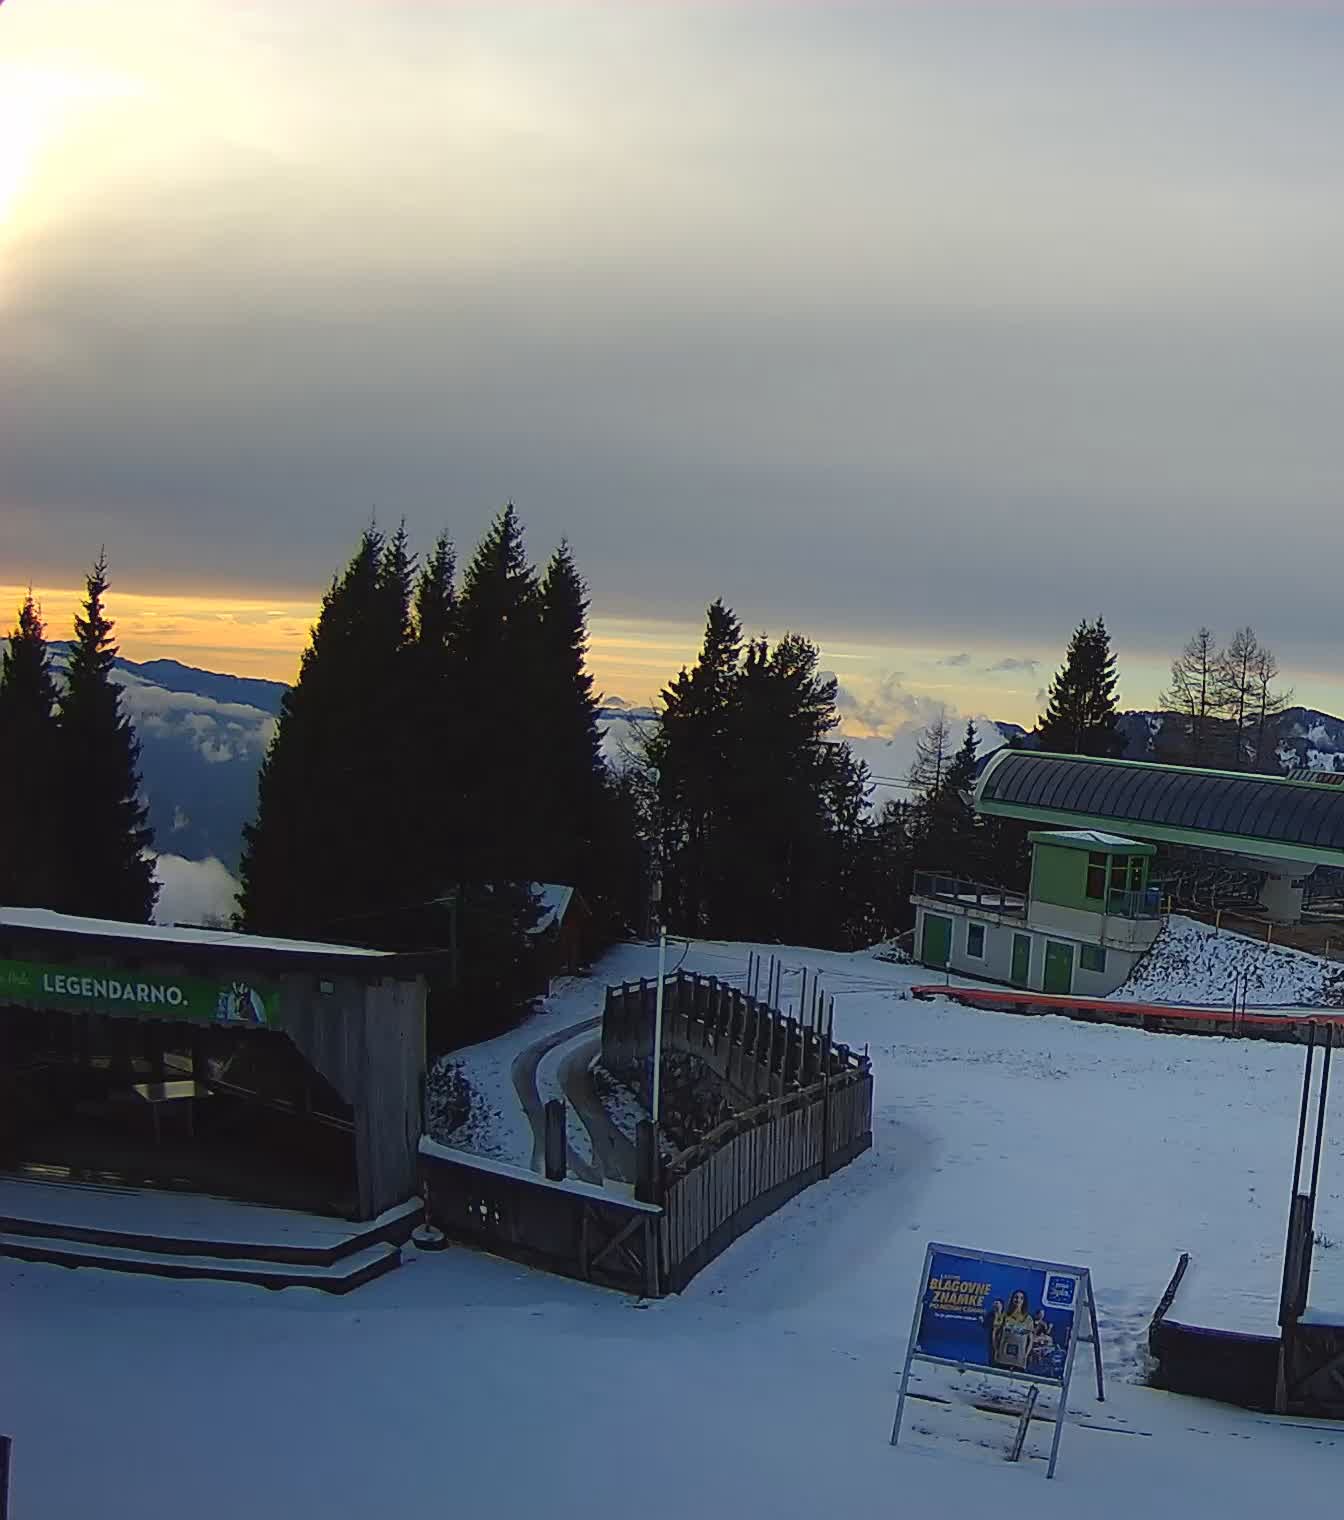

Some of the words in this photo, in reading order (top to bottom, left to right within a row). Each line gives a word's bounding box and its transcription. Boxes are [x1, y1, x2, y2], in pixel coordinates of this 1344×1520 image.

[43, 973, 189, 1006] LEGENDARNO.
[928, 1278, 992, 1296] BLAGOVNE
[932, 1290, 985, 1307] ZNAMKE
